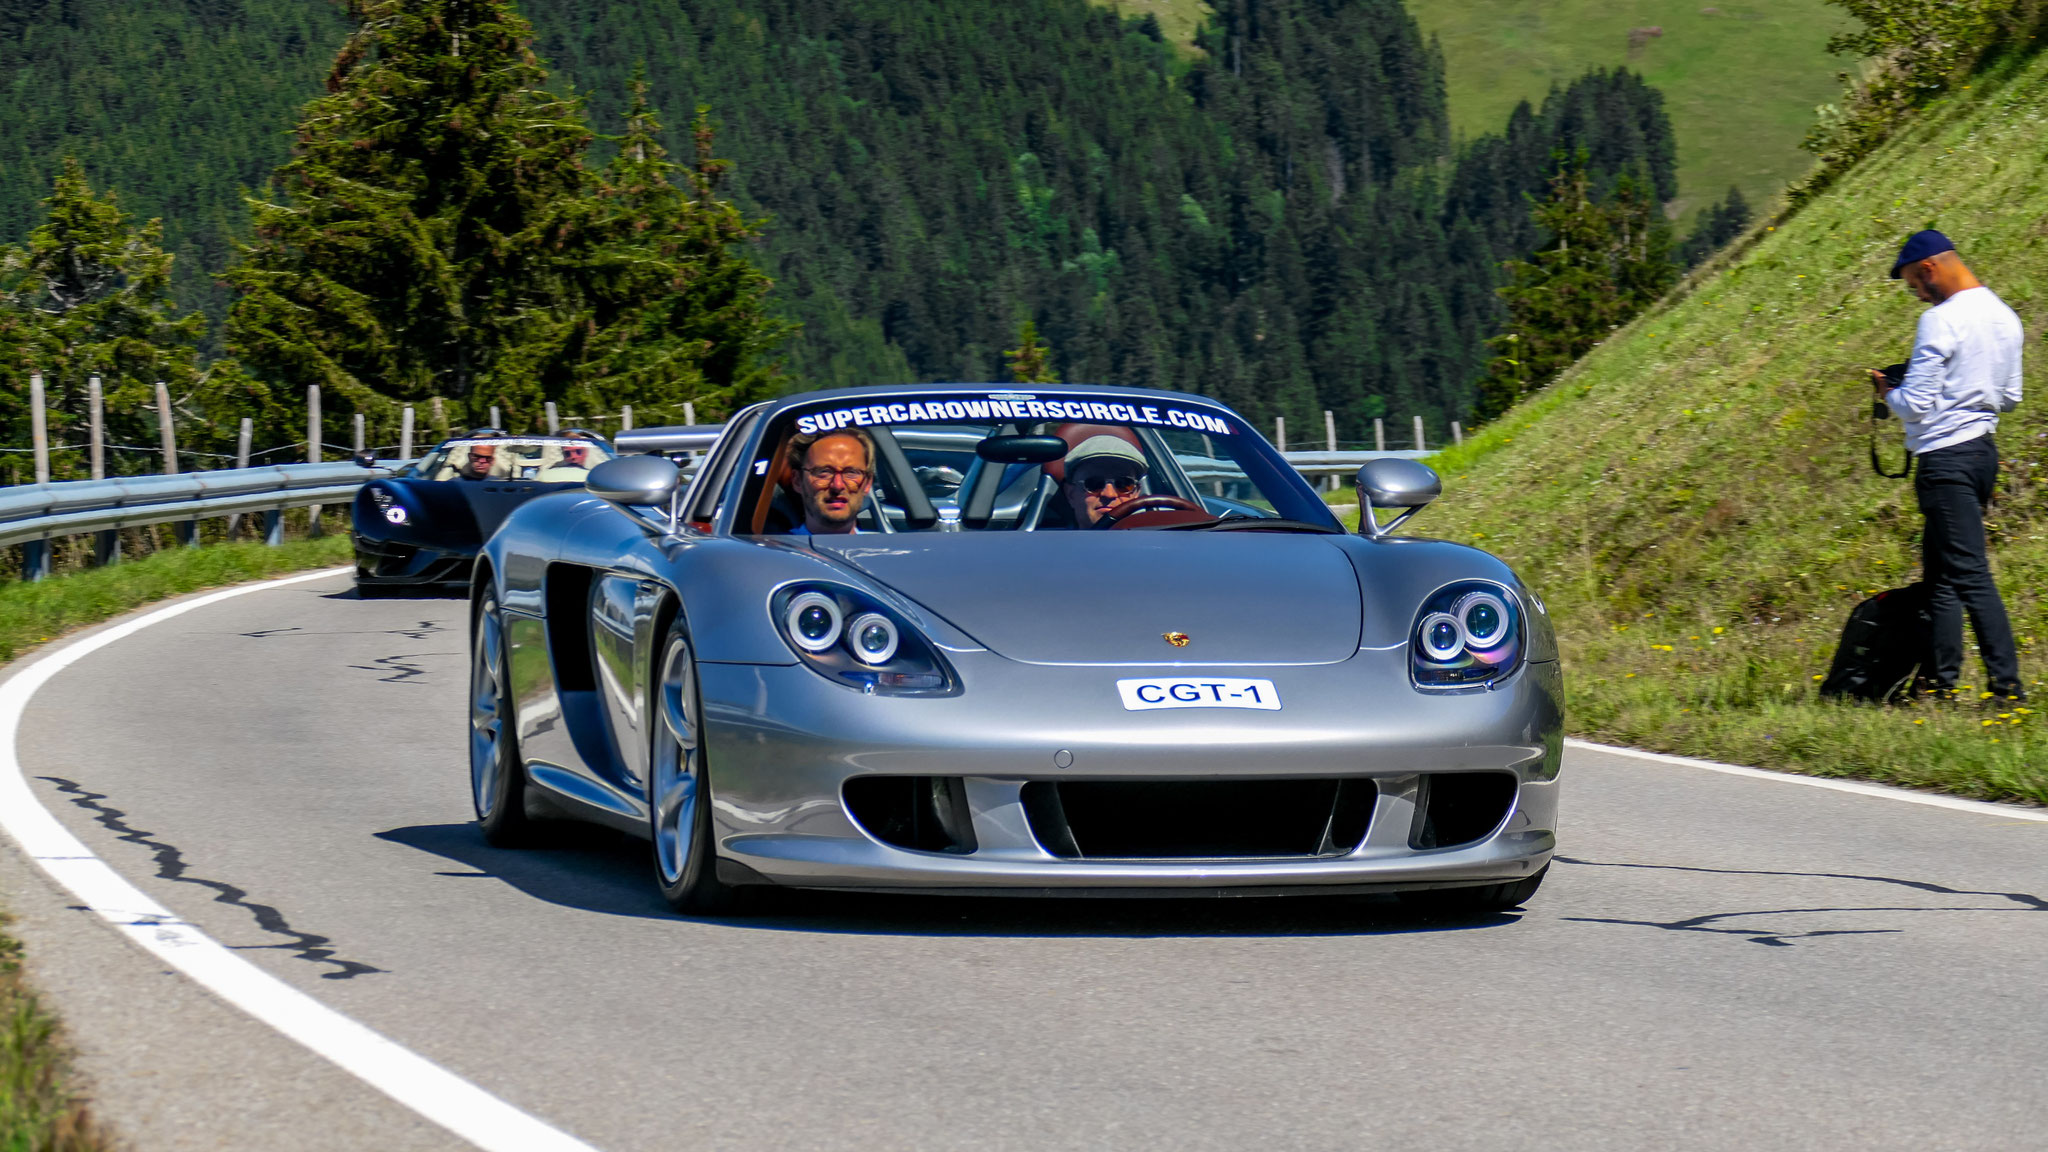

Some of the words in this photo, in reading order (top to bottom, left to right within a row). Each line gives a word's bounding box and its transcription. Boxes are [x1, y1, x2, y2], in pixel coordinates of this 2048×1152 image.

[796, 400, 1231, 435] SUPERCAROWNERSCIRCLE.COM
[754, 460, 769, 475] 1
[1136, 683, 1263, 704] CGT-1
